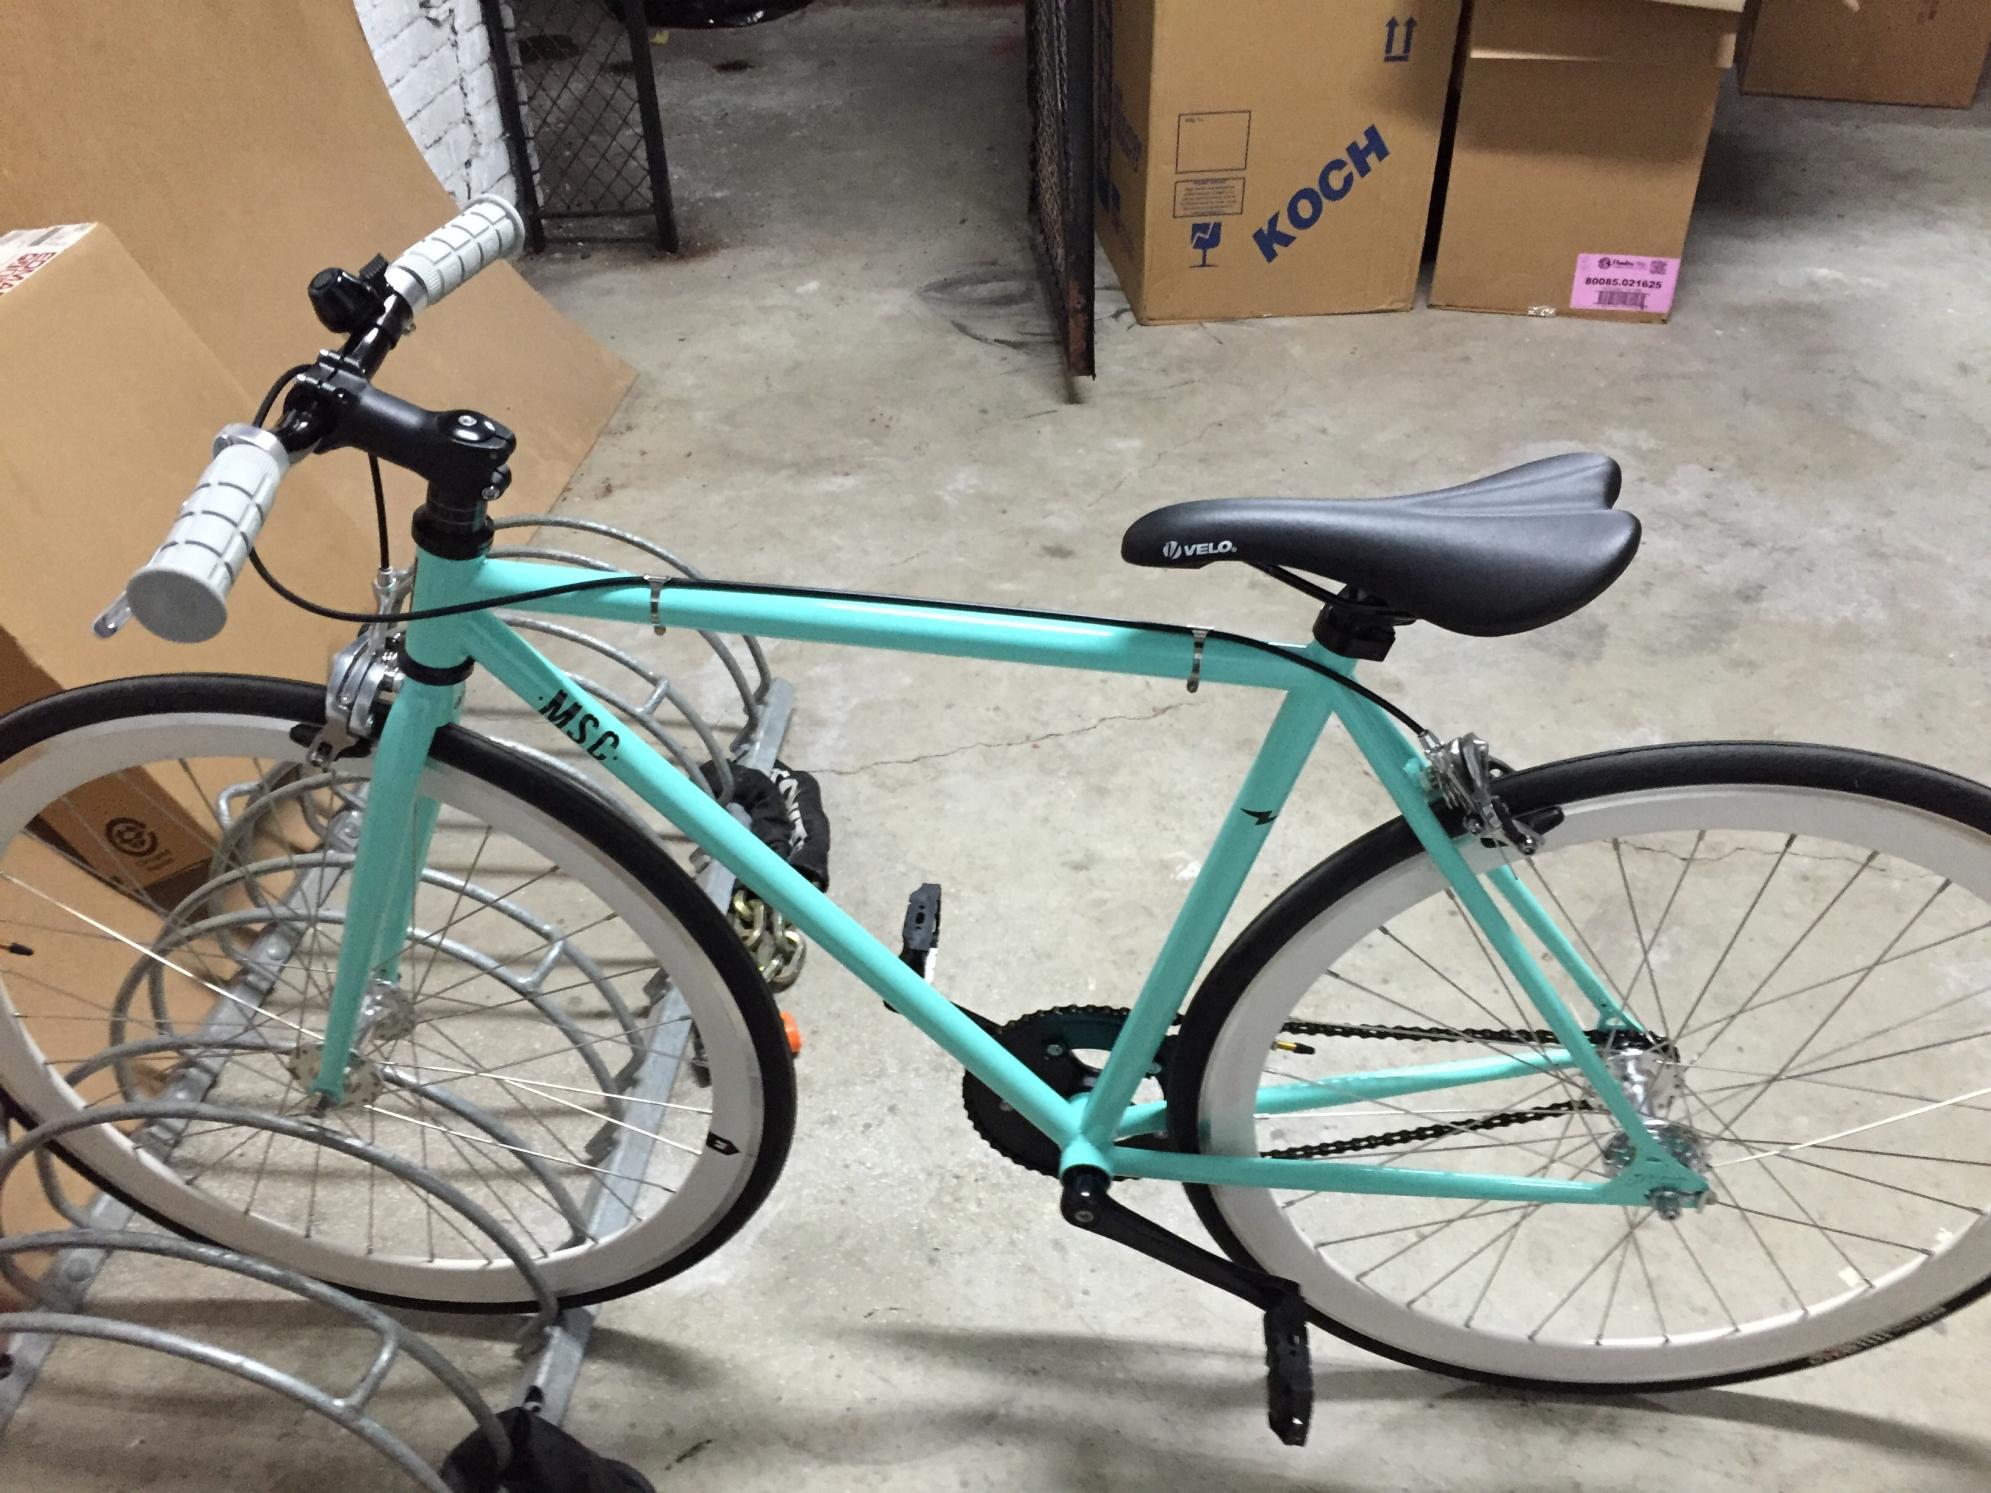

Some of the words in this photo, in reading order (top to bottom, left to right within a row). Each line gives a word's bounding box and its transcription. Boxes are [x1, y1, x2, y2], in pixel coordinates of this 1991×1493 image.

[1252, 124, 1390, 263] KOCH
[1585, 276, 1663, 290] 80085.021625
[1183, 540, 1233, 556] VELO
[539, 689, 620, 761] MSC
